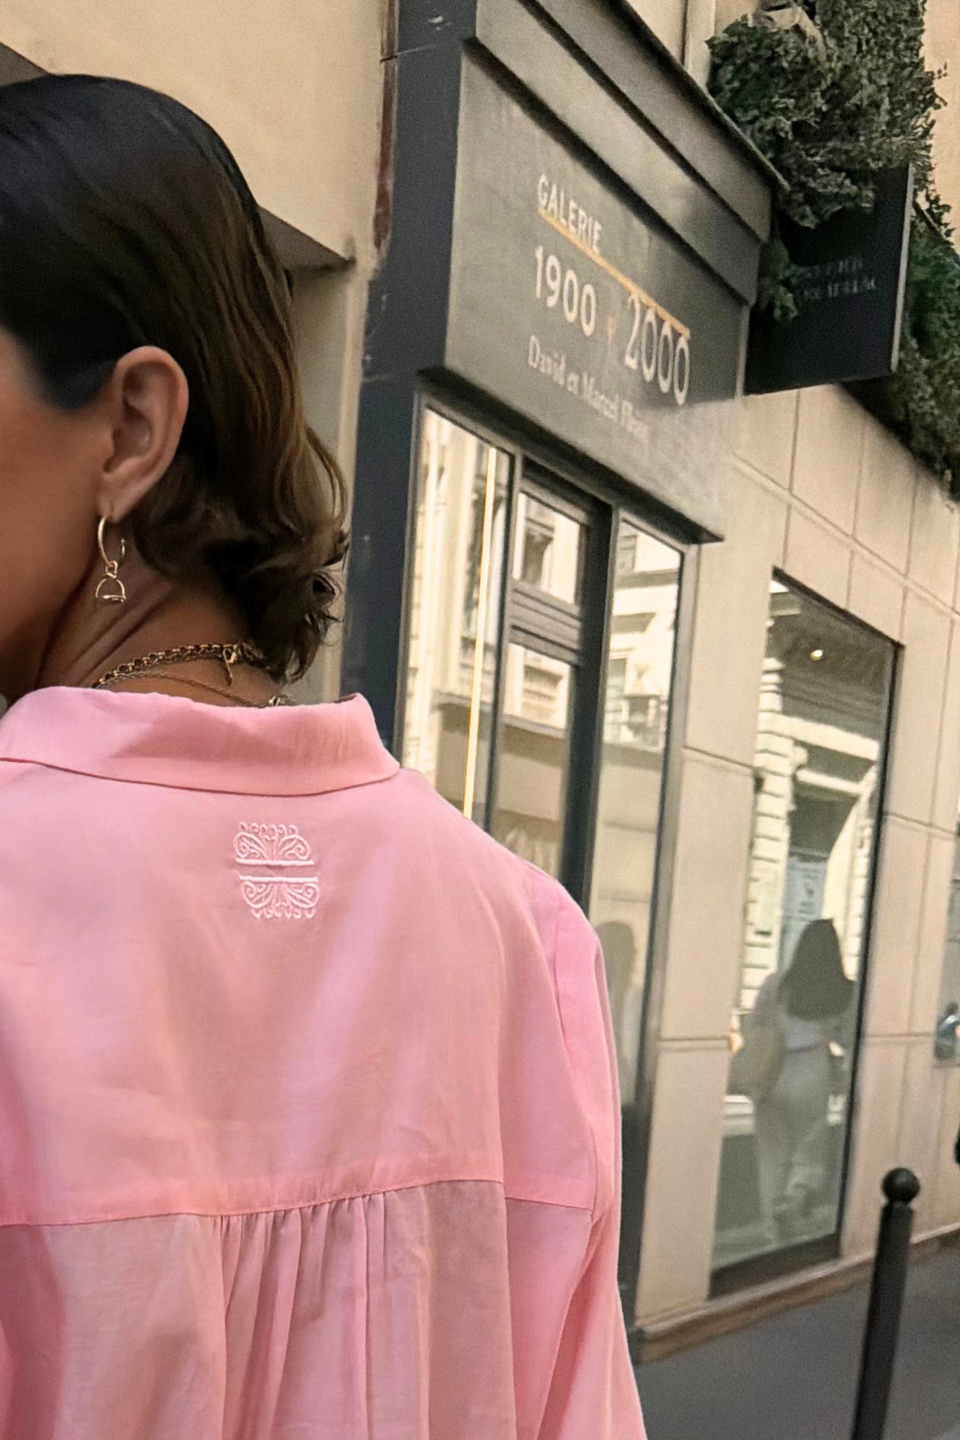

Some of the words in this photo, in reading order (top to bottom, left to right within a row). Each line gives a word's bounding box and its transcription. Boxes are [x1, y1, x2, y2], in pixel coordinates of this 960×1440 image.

[537, 173, 602, 255] GALERIE
[535, 245, 597, 336] 1900
[624, 293, 690, 406] 2000
